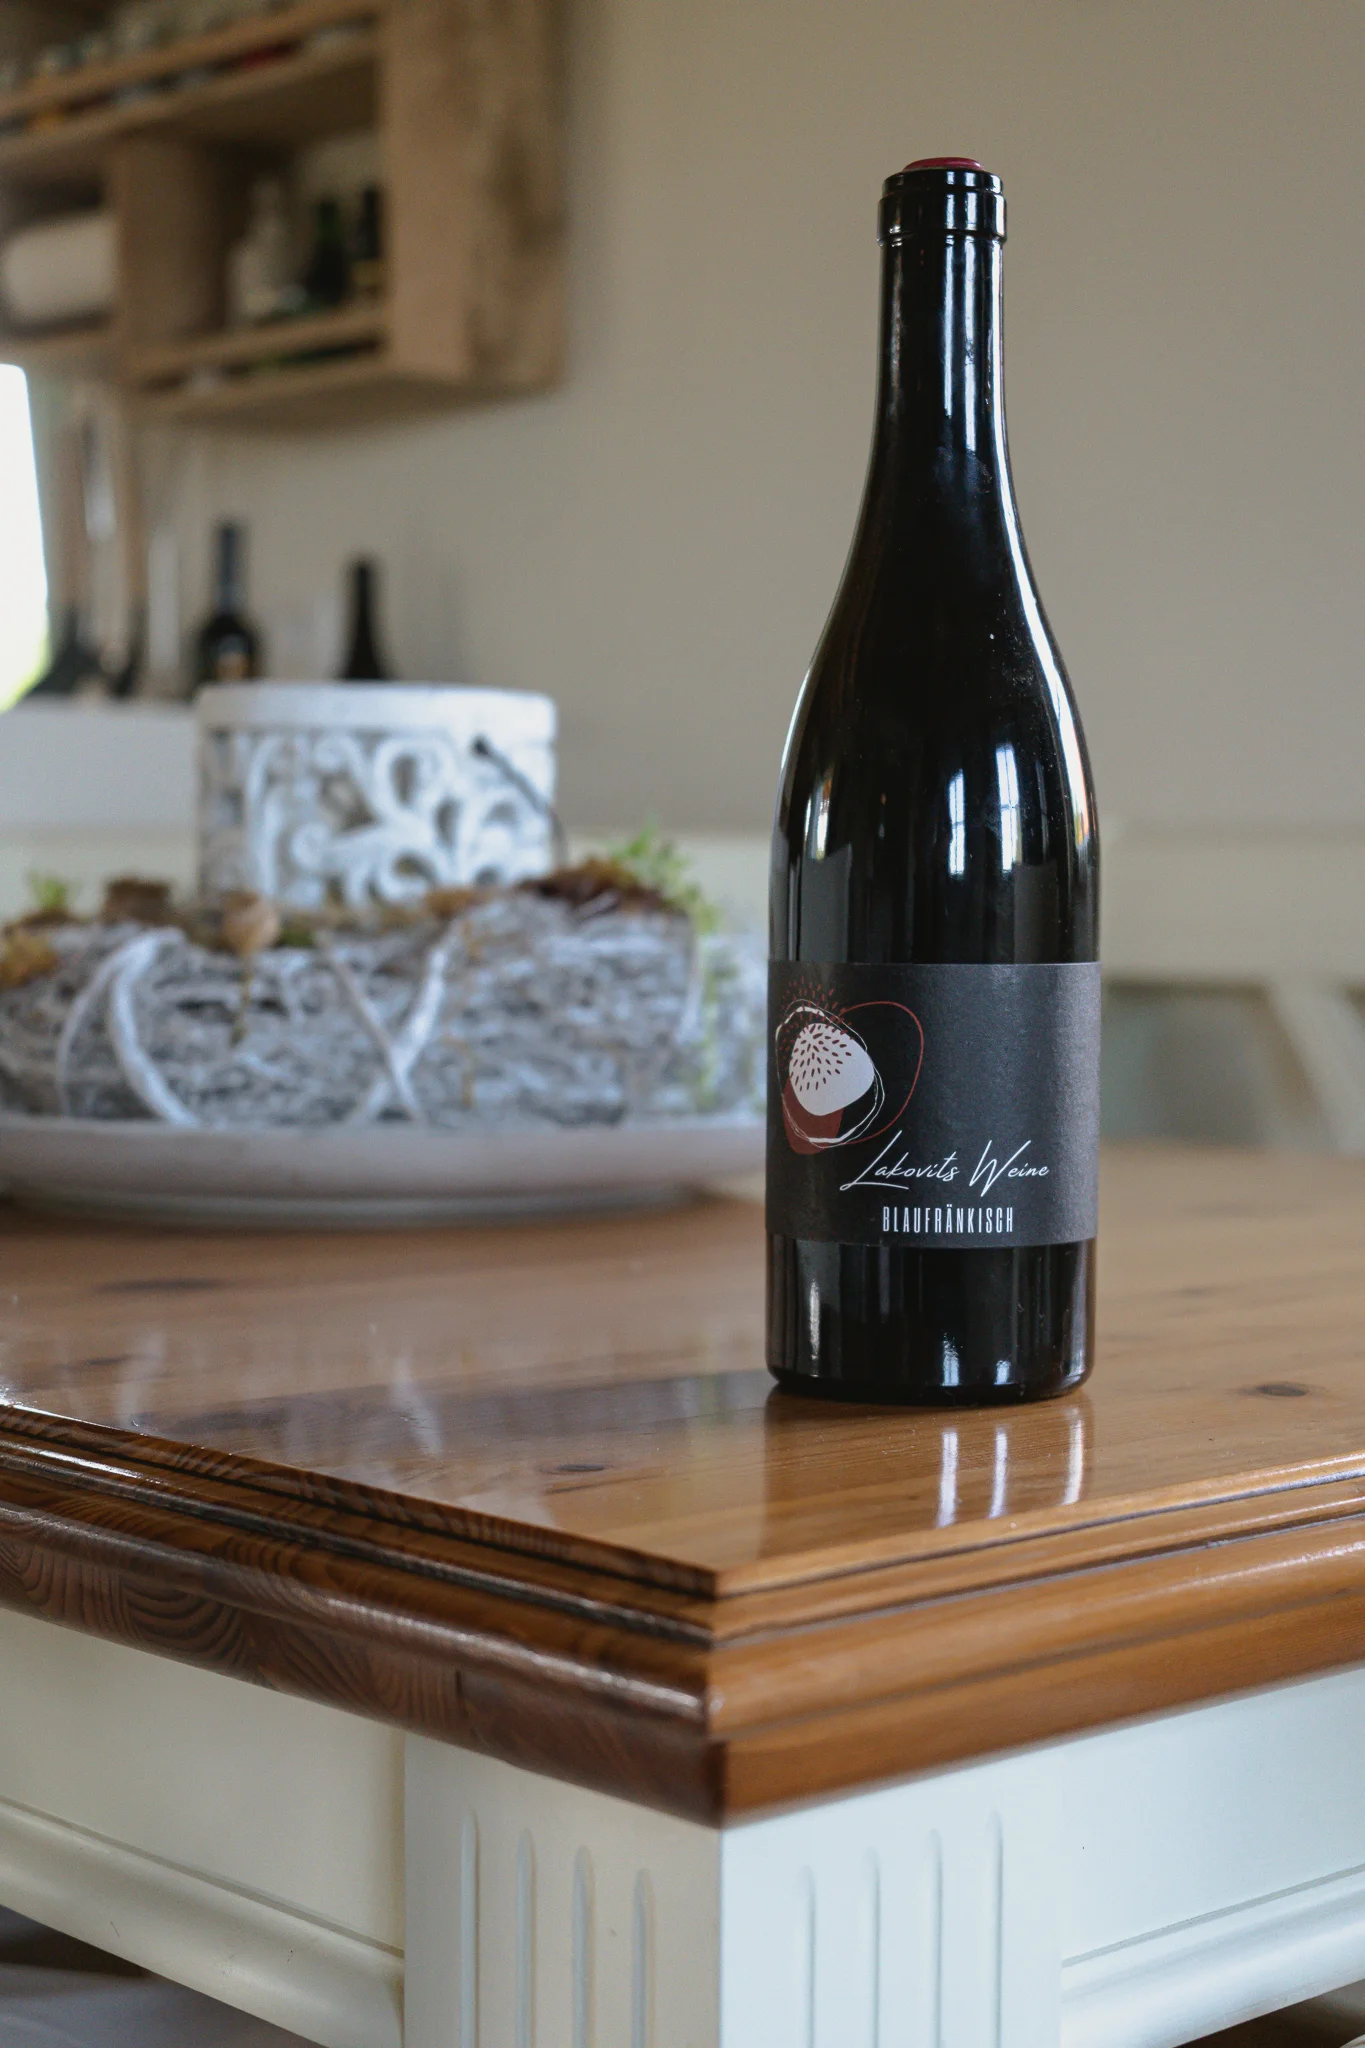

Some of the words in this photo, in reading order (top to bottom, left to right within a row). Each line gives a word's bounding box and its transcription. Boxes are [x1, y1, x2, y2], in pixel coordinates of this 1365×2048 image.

[839, 1130, 960, 1191] Lakovits
[969, 1139, 1050, 1197] Weine
[882, 1204, 1014, 1233] BLAUFRÄNKISCH
